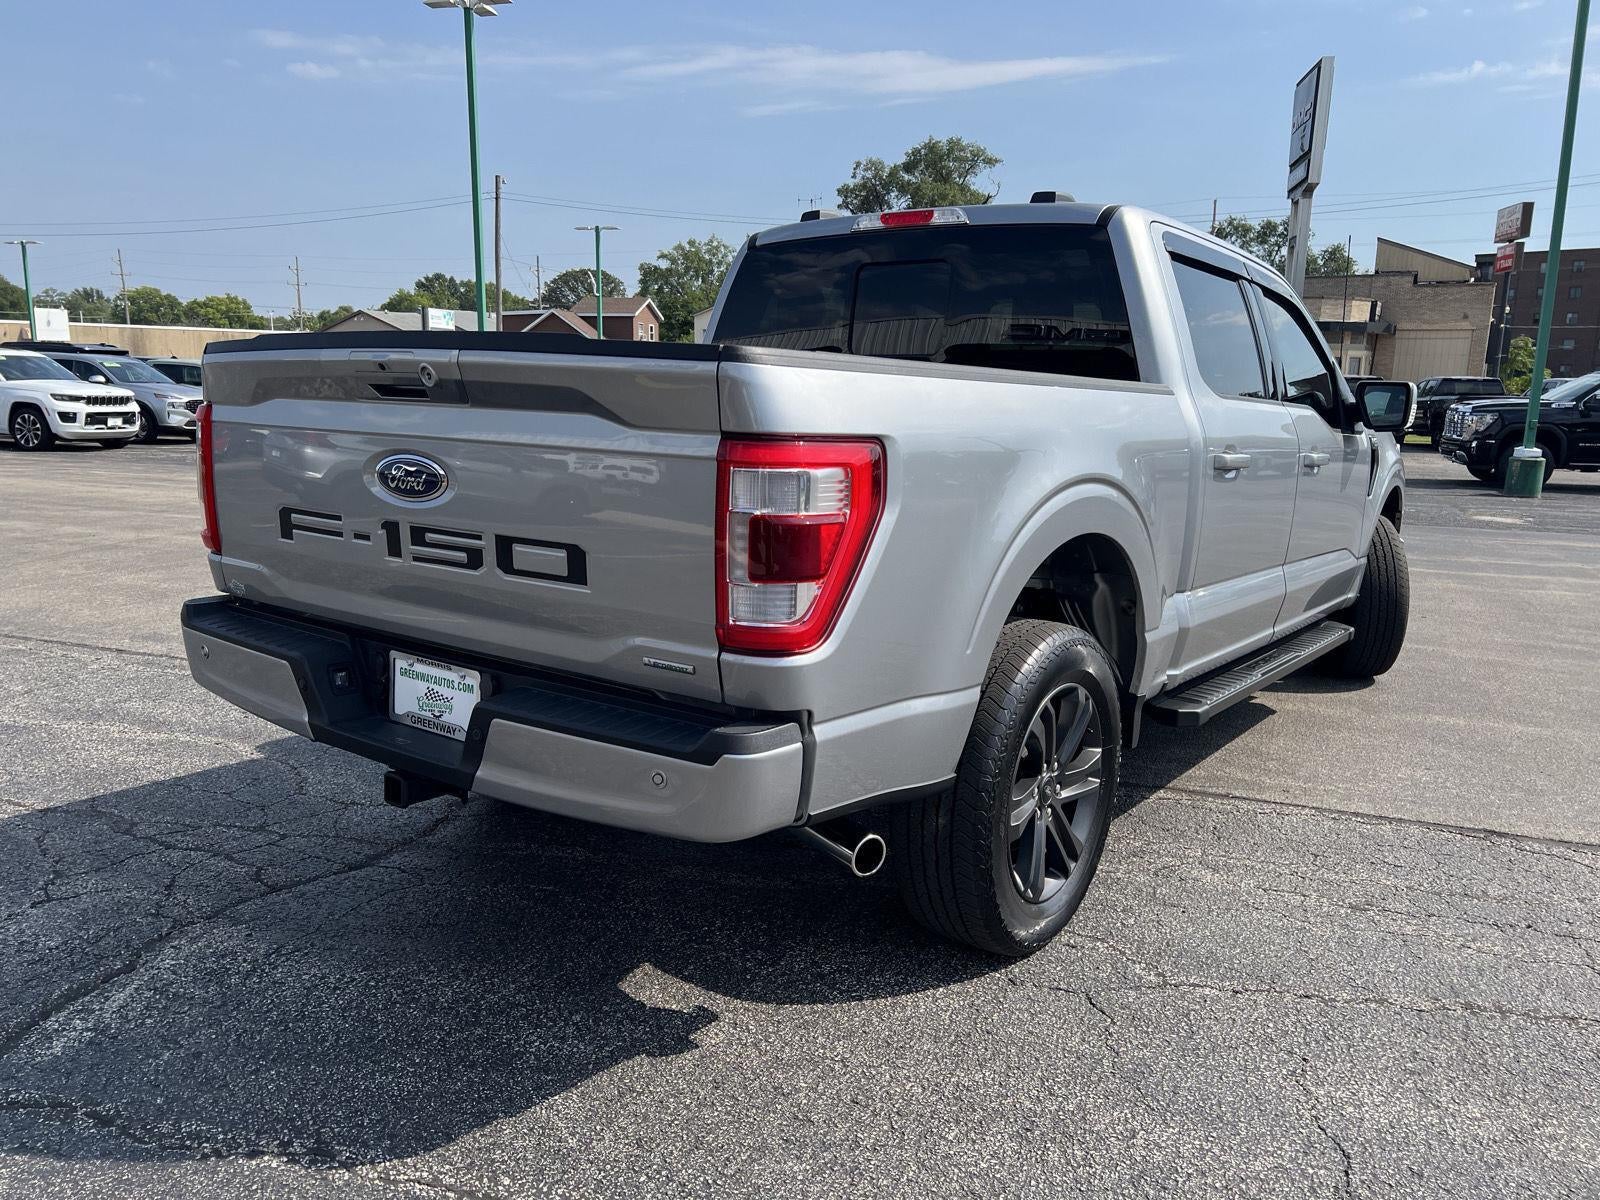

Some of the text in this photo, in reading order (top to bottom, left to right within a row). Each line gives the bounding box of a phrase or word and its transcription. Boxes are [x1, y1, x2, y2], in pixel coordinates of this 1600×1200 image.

[385, 463, 427, 491] Ford
[278, 506, 590, 591] F-150
[416, 657, 453, 671] MORRIS
[399, 666, 475, 695] GREENWAYAUTOS.COM
[416, 695, 453, 715] Greenway
[410, 714, 457, 737] GREENWAY
